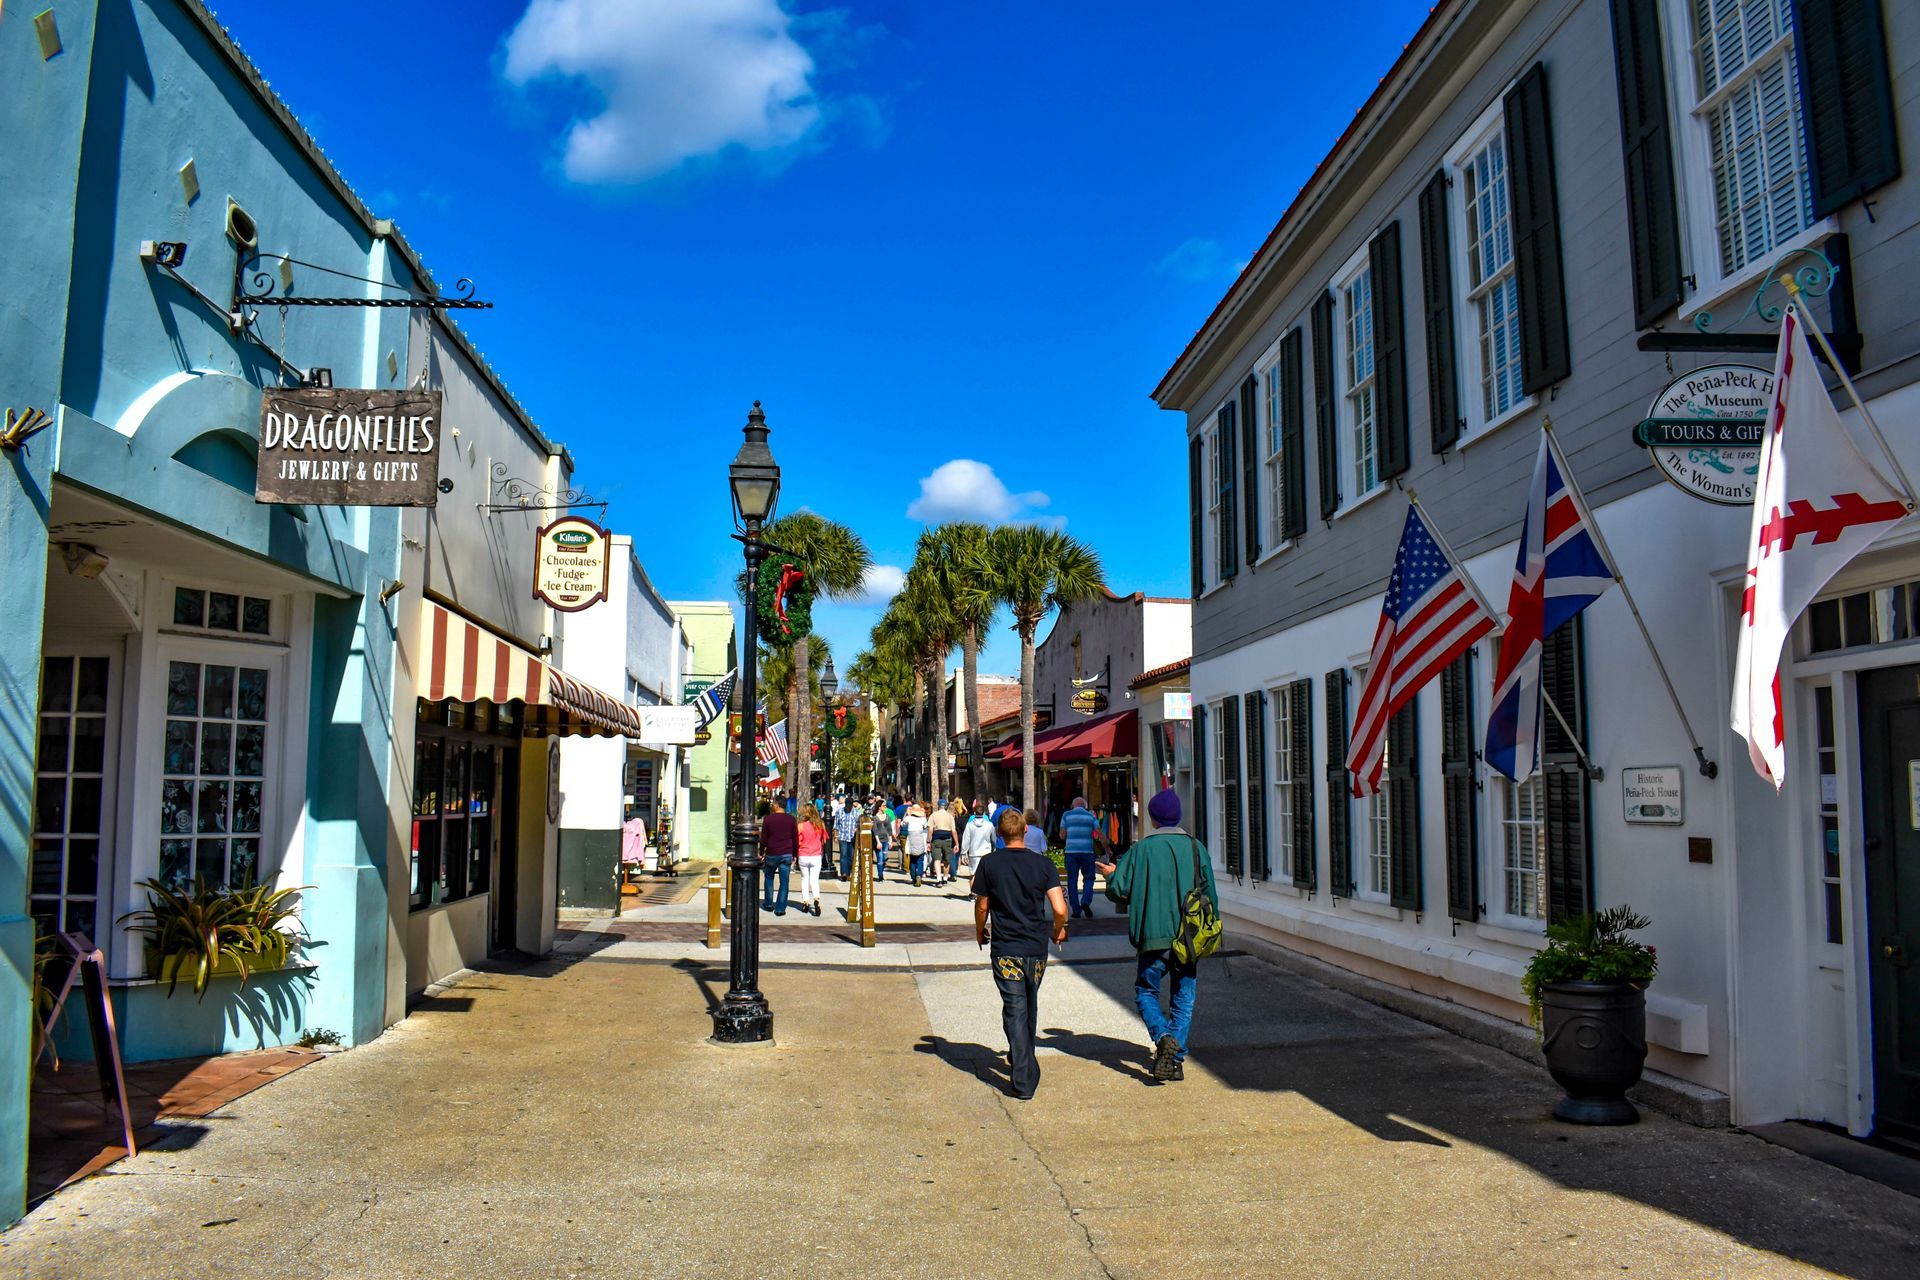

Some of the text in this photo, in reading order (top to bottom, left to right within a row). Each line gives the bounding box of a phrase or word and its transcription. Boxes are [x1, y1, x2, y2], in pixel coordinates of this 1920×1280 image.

[1663, 393, 1688, 415] The
[1686, 371, 1757, 398] Peña-Peck
[1705, 394, 1763, 407] Museum
[1717, 410, 1733, 418] Circa
[265, 412, 434, 454] DRAGONFLIES
[1661, 425, 1715, 440] TOURS
[1720, 425, 1732, 440] &
[278, 460, 418, 481] JEWLERY & GIFTS
[1667, 451, 1752, 498] The Woman's
[559, 533, 587, 543] Kilwin's
[546, 554, 597, 566] Chocolates
[557, 568, 585, 581] Fudge
[547, 581, 593, 591] Ice Cream
[1637, 773, 1664, 784] Historic
[1625, 786, 1679, 797] Peña-Peck House
